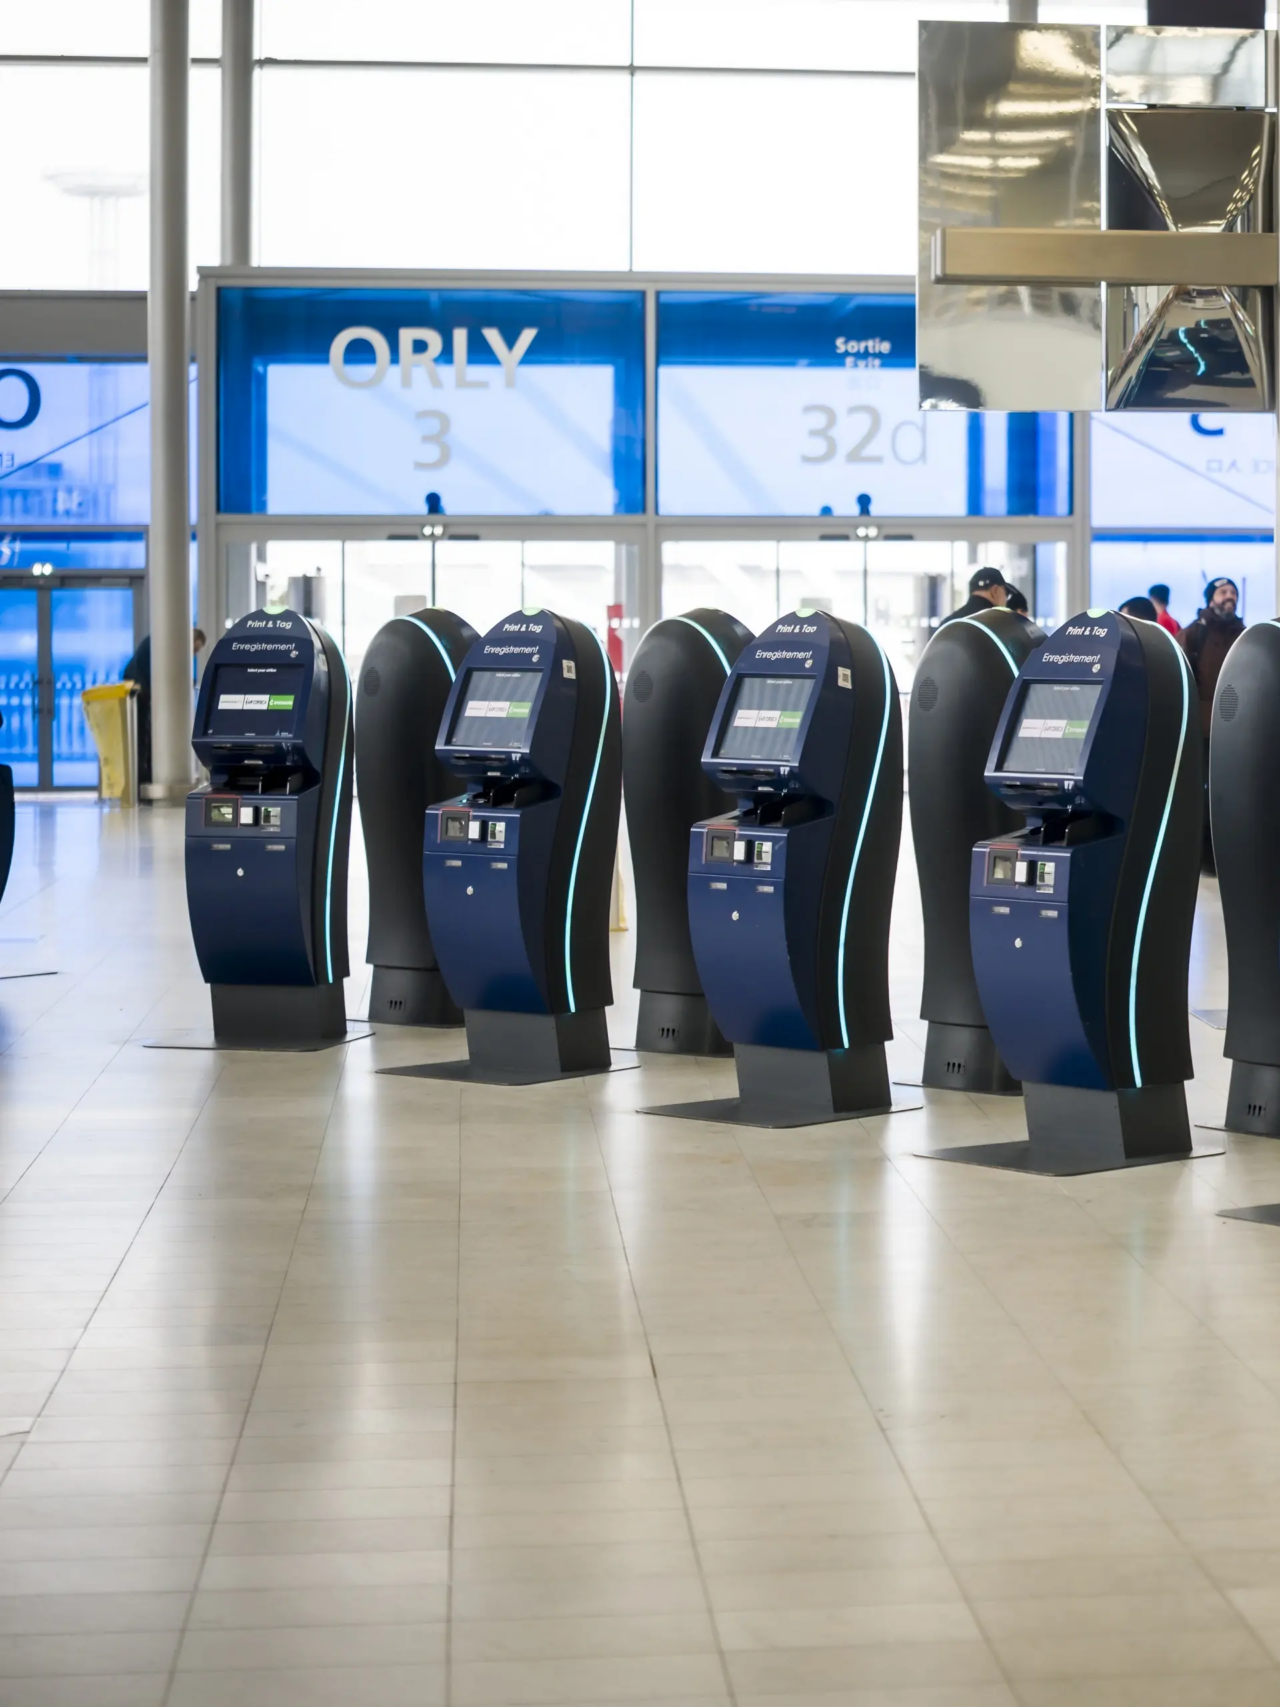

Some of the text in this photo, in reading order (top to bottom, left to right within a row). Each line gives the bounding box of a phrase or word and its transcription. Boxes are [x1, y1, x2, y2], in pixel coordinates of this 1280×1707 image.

[835, 336, 891, 354] Sortie
[329, 326, 539, 389] ORLY
[413, 409, 452, 471] 3
[276, 620, 292, 629] Tag
[528, 624, 543, 633] Tag
[776, 625, 794, 633] Print
[794, 625, 800, 633] &
[1066, 626, 1108, 637] Print & Tag
[232, 643, 295, 652] Enregistrement
[484, 646, 539, 655] Enregistrement
[755, 650, 812, 660] Enregistrement
[1042, 653, 1100, 664] Enregistrement
